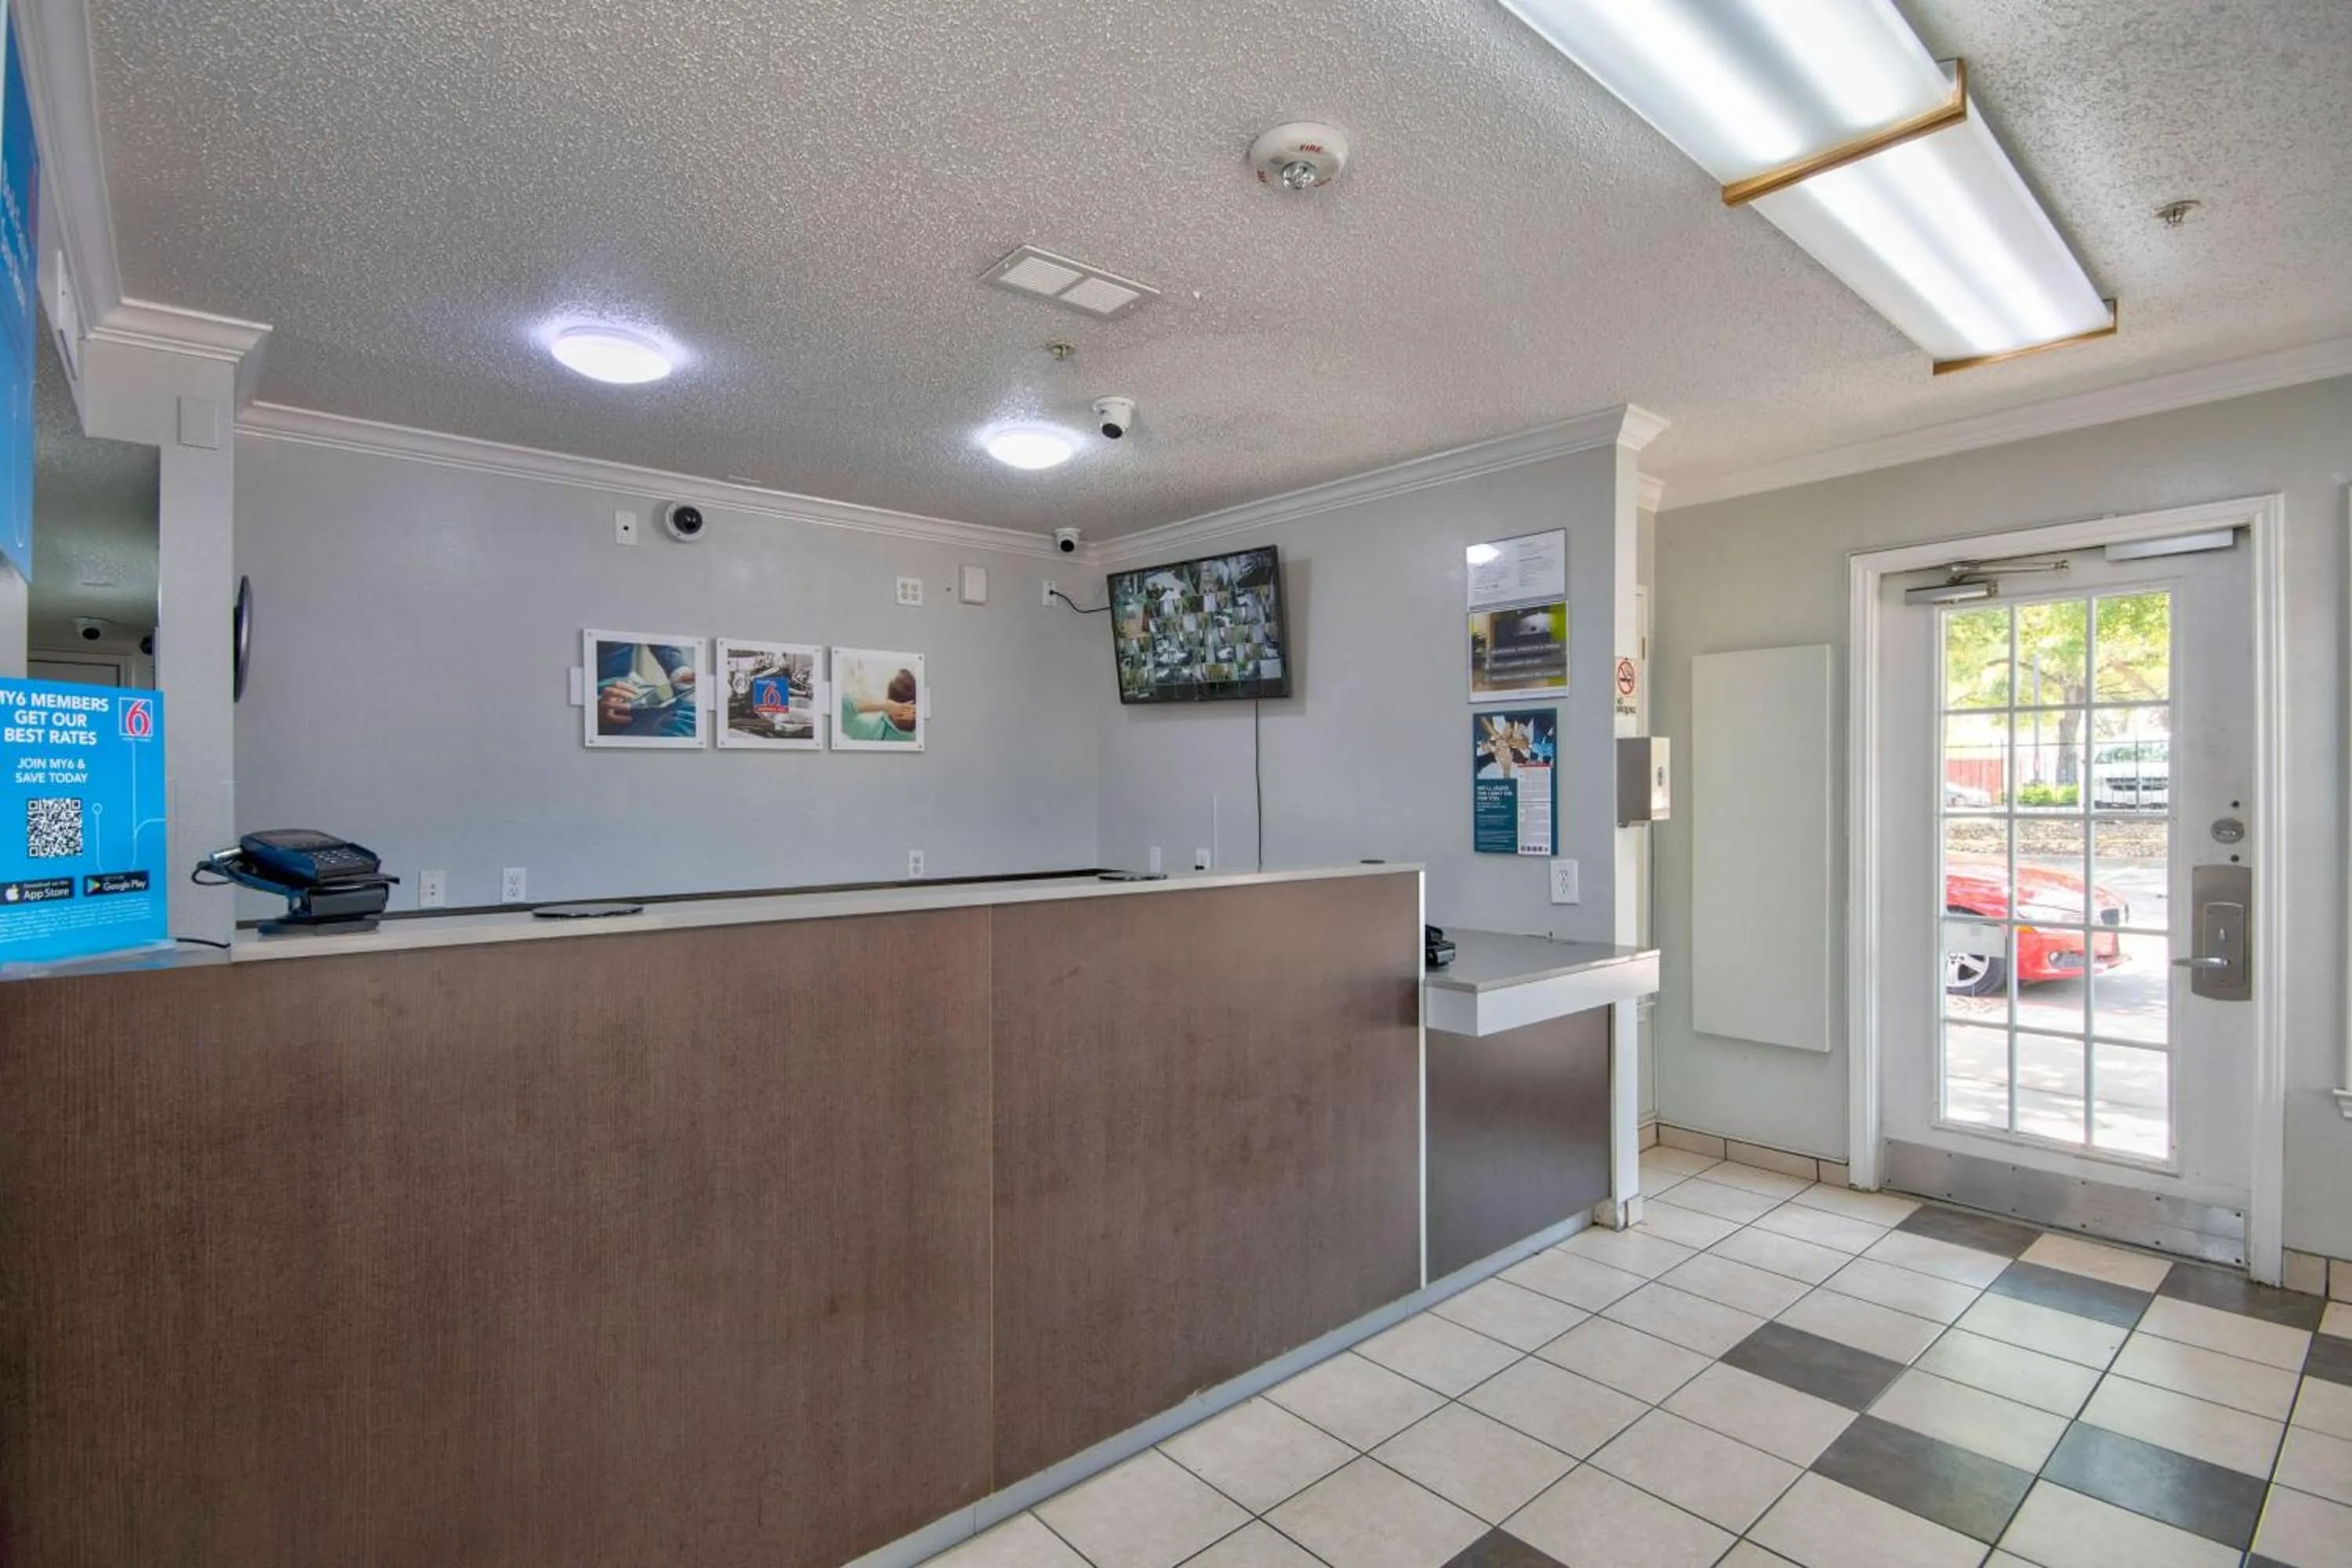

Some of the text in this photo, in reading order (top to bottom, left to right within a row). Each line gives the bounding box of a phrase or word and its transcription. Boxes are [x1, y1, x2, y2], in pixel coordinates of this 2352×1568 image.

[31, 693, 109, 712] MEMBERS
[14, 710, 88, 728] GET OUR
[125, 699, 151, 735] 6
[4, 728, 98, 746] BEST RATES
[17, 758, 85, 769] JOIN MY6 &
[15, 772, 89, 784] SAVE TODAY
[103, 879, 147, 891] Google Play
[24, 887, 70, 900] App Store
